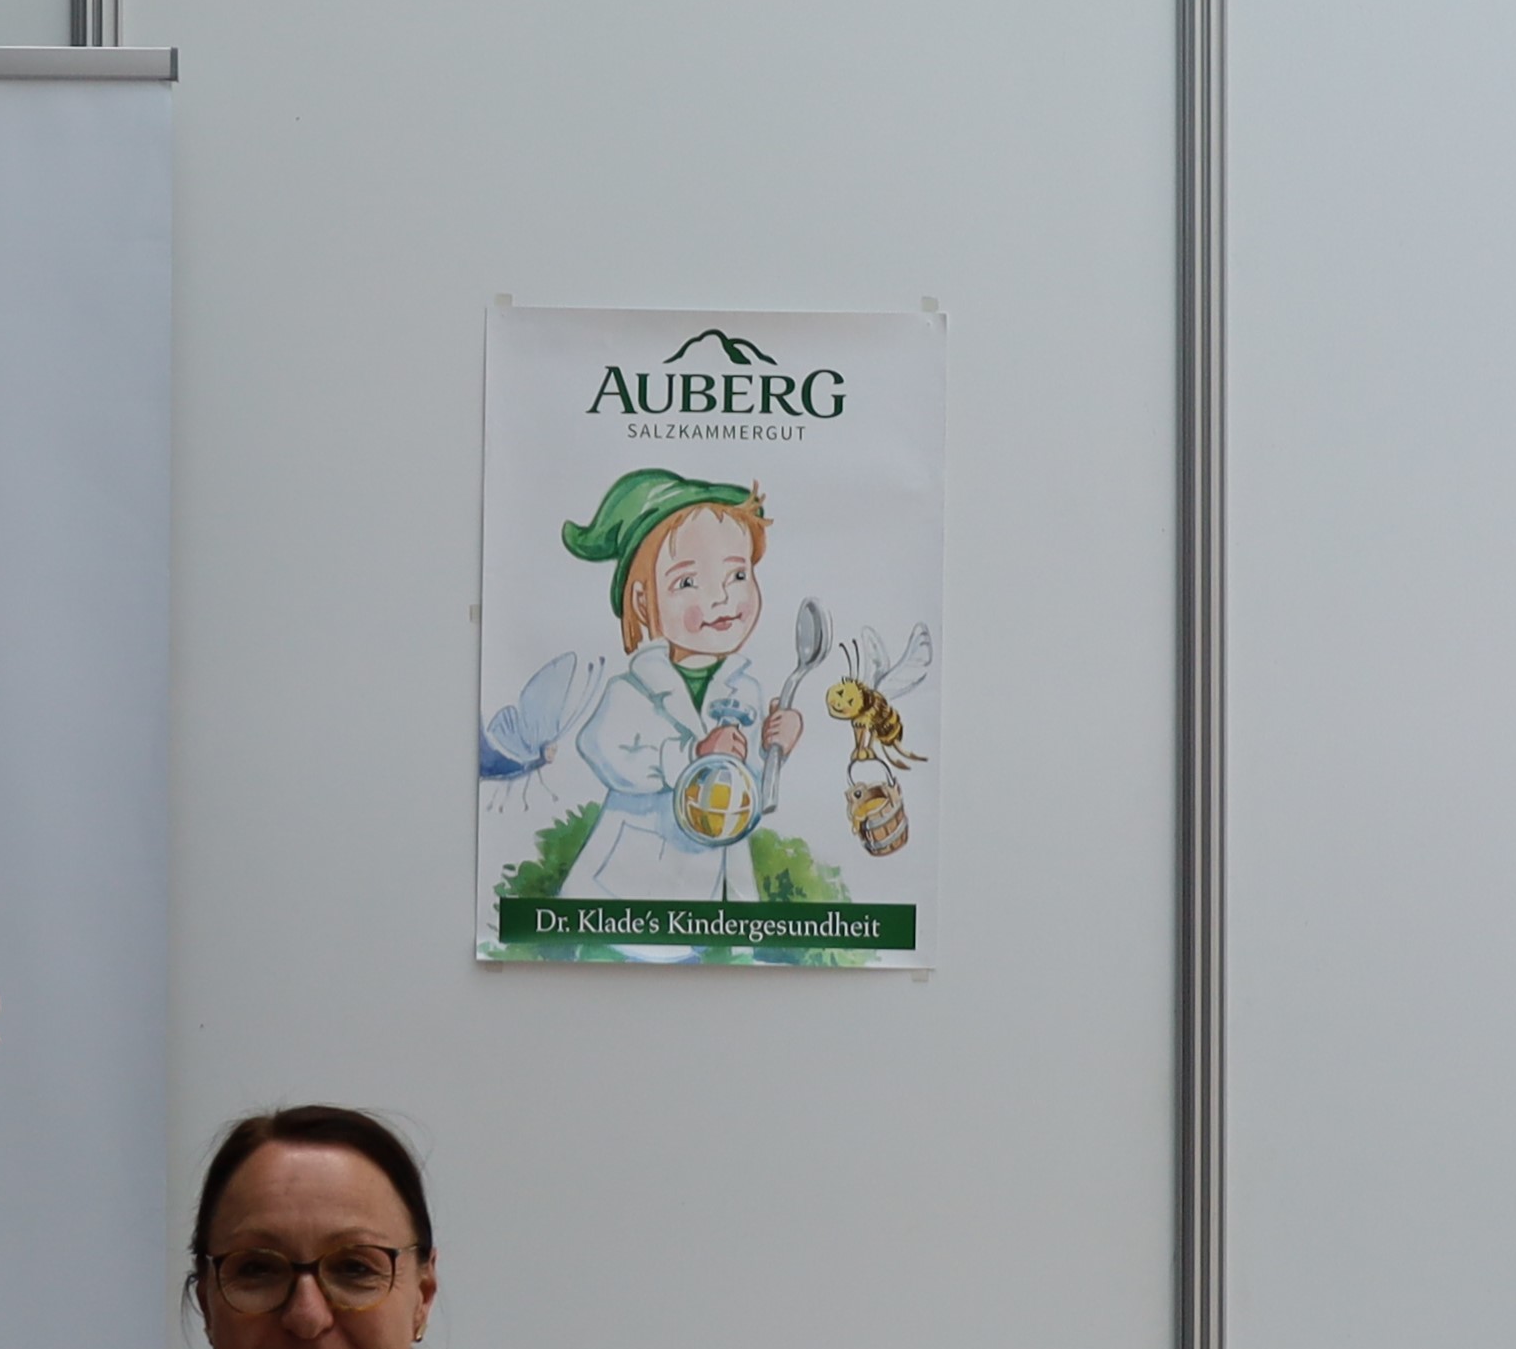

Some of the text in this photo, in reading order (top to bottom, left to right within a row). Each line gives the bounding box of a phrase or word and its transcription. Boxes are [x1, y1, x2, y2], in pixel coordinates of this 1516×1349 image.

[586, 366, 847, 419] AUBERG
[627, 423, 806, 441] SALZKAMMERGUT
[535, 908, 570, 933] Dr.
[667, 910, 880, 939] Kindergesundheit
